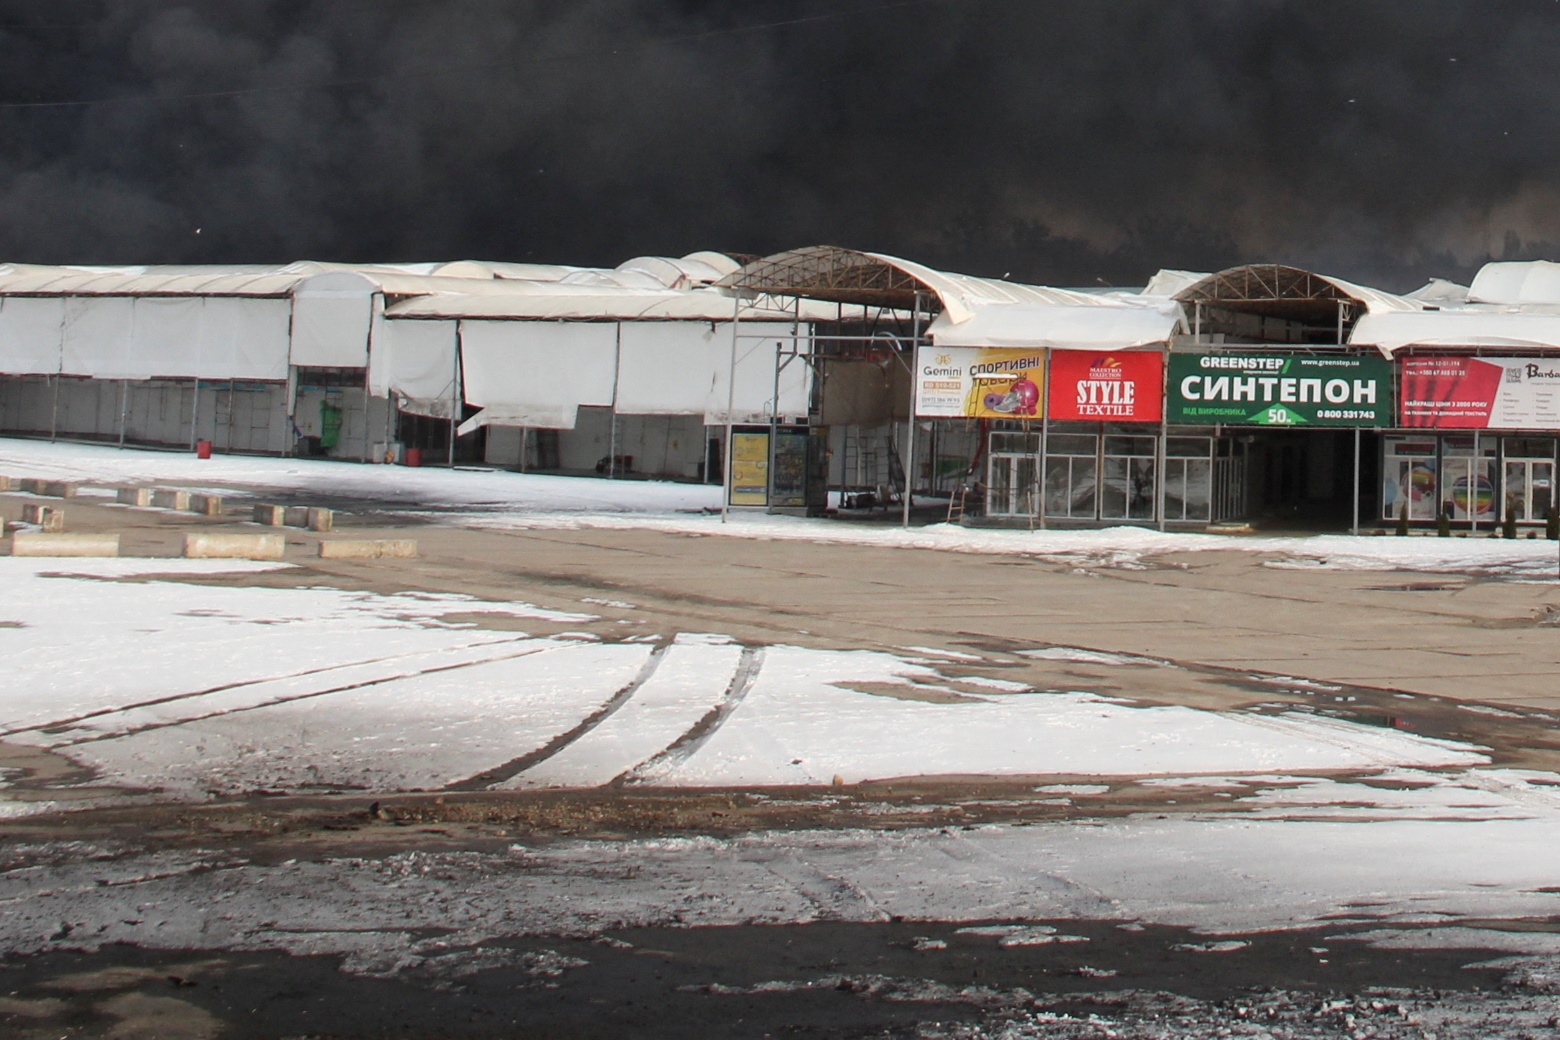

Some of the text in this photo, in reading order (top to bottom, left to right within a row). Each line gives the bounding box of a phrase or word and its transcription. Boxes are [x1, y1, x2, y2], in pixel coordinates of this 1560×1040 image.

[969, 356, 1039, 376] СПОРТИВНІ
[1200, 356, 1284, 369] GREENSTEP
[1301, 359, 1360, 367] www.greenstep.ua
[923, 366, 962, 377] Gemini
[1077, 380, 1135, 404] STYLE
[1180, 375, 1376, 404] СИНТЕПОН
[1077, 404, 1134, 415] TEXTILE
[1182, 407, 1246, 416] ВІД ВИРОБНИКА
